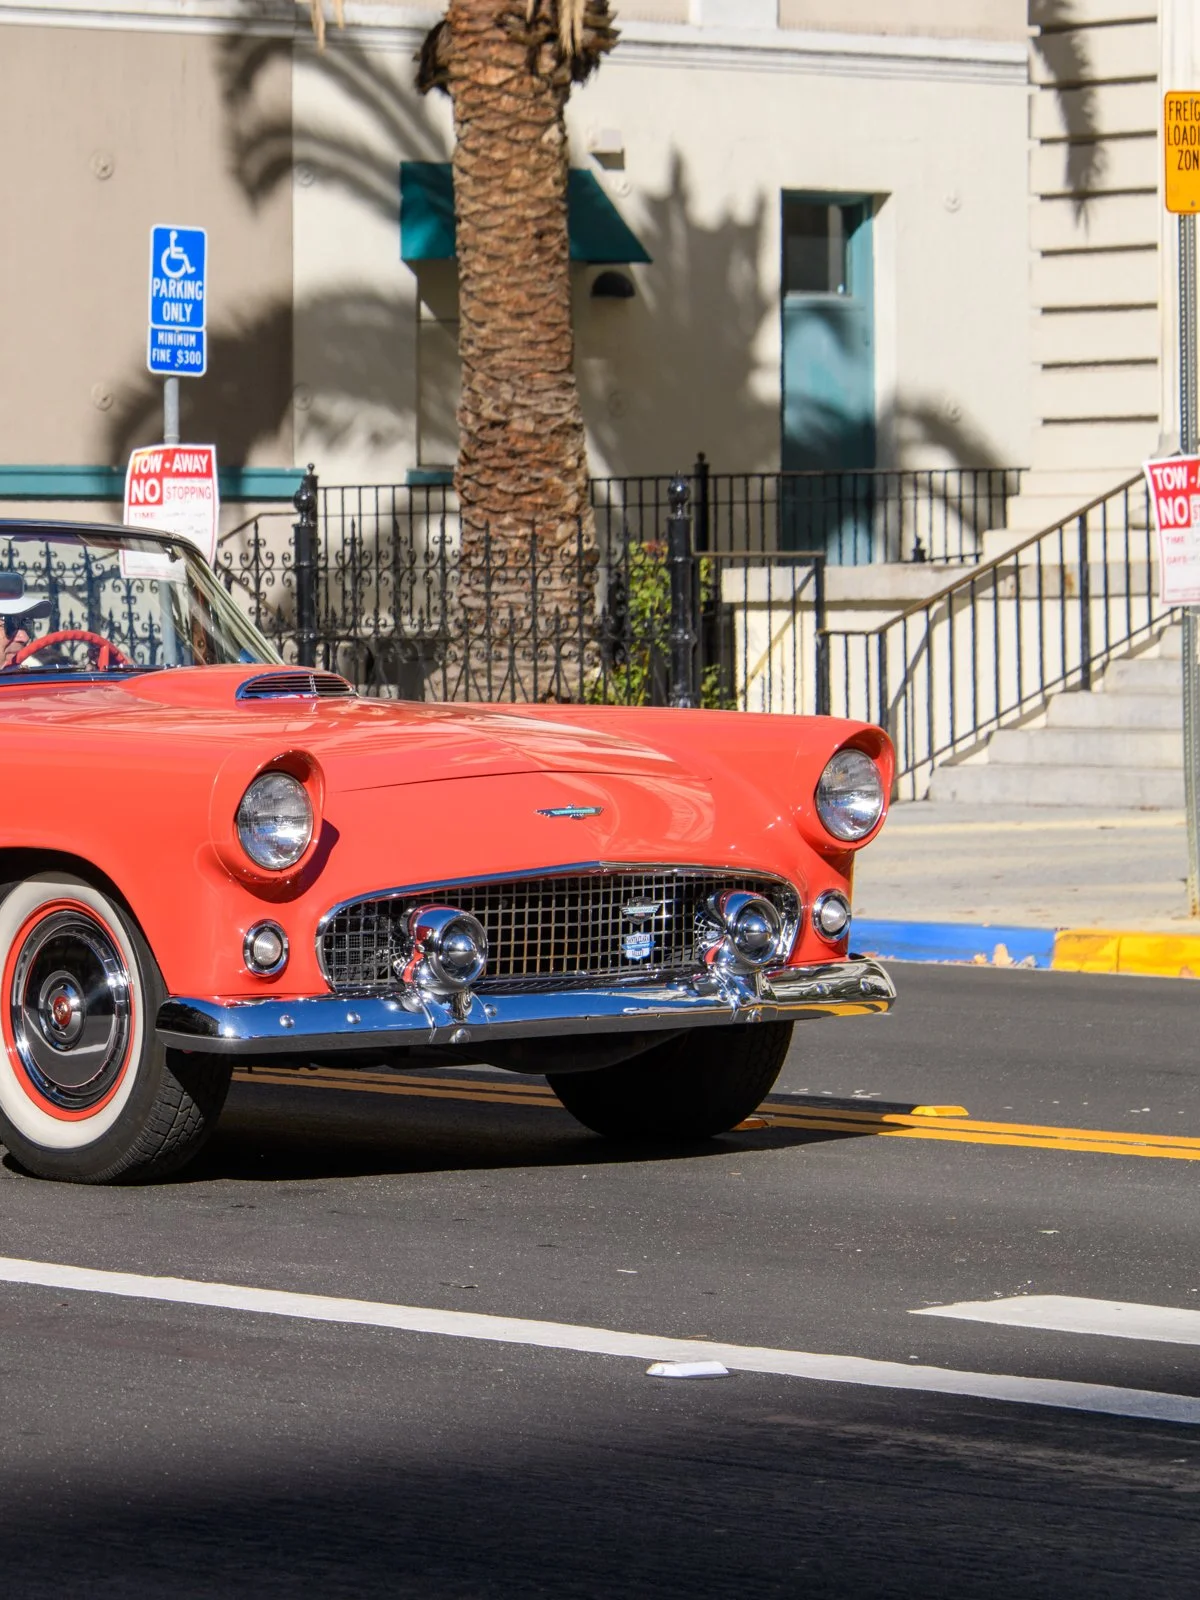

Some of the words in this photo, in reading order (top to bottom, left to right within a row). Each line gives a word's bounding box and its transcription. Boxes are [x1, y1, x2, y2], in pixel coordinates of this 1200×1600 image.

[1177, 149, 1200, 171] ZON
[152, 277, 203, 301] PARKING
[162, 301, 193, 323] ONLY
[157, 331, 197, 348] MINIMUM
[152, 348, 172, 363] FINE
[176, 349, 202, 366] $300
[130, 477, 160, 504] NO
[165, 484, 212, 501] STOPPING
[134, 511, 156, 520] TIME
[1158, 496, 1188, 526] NO
